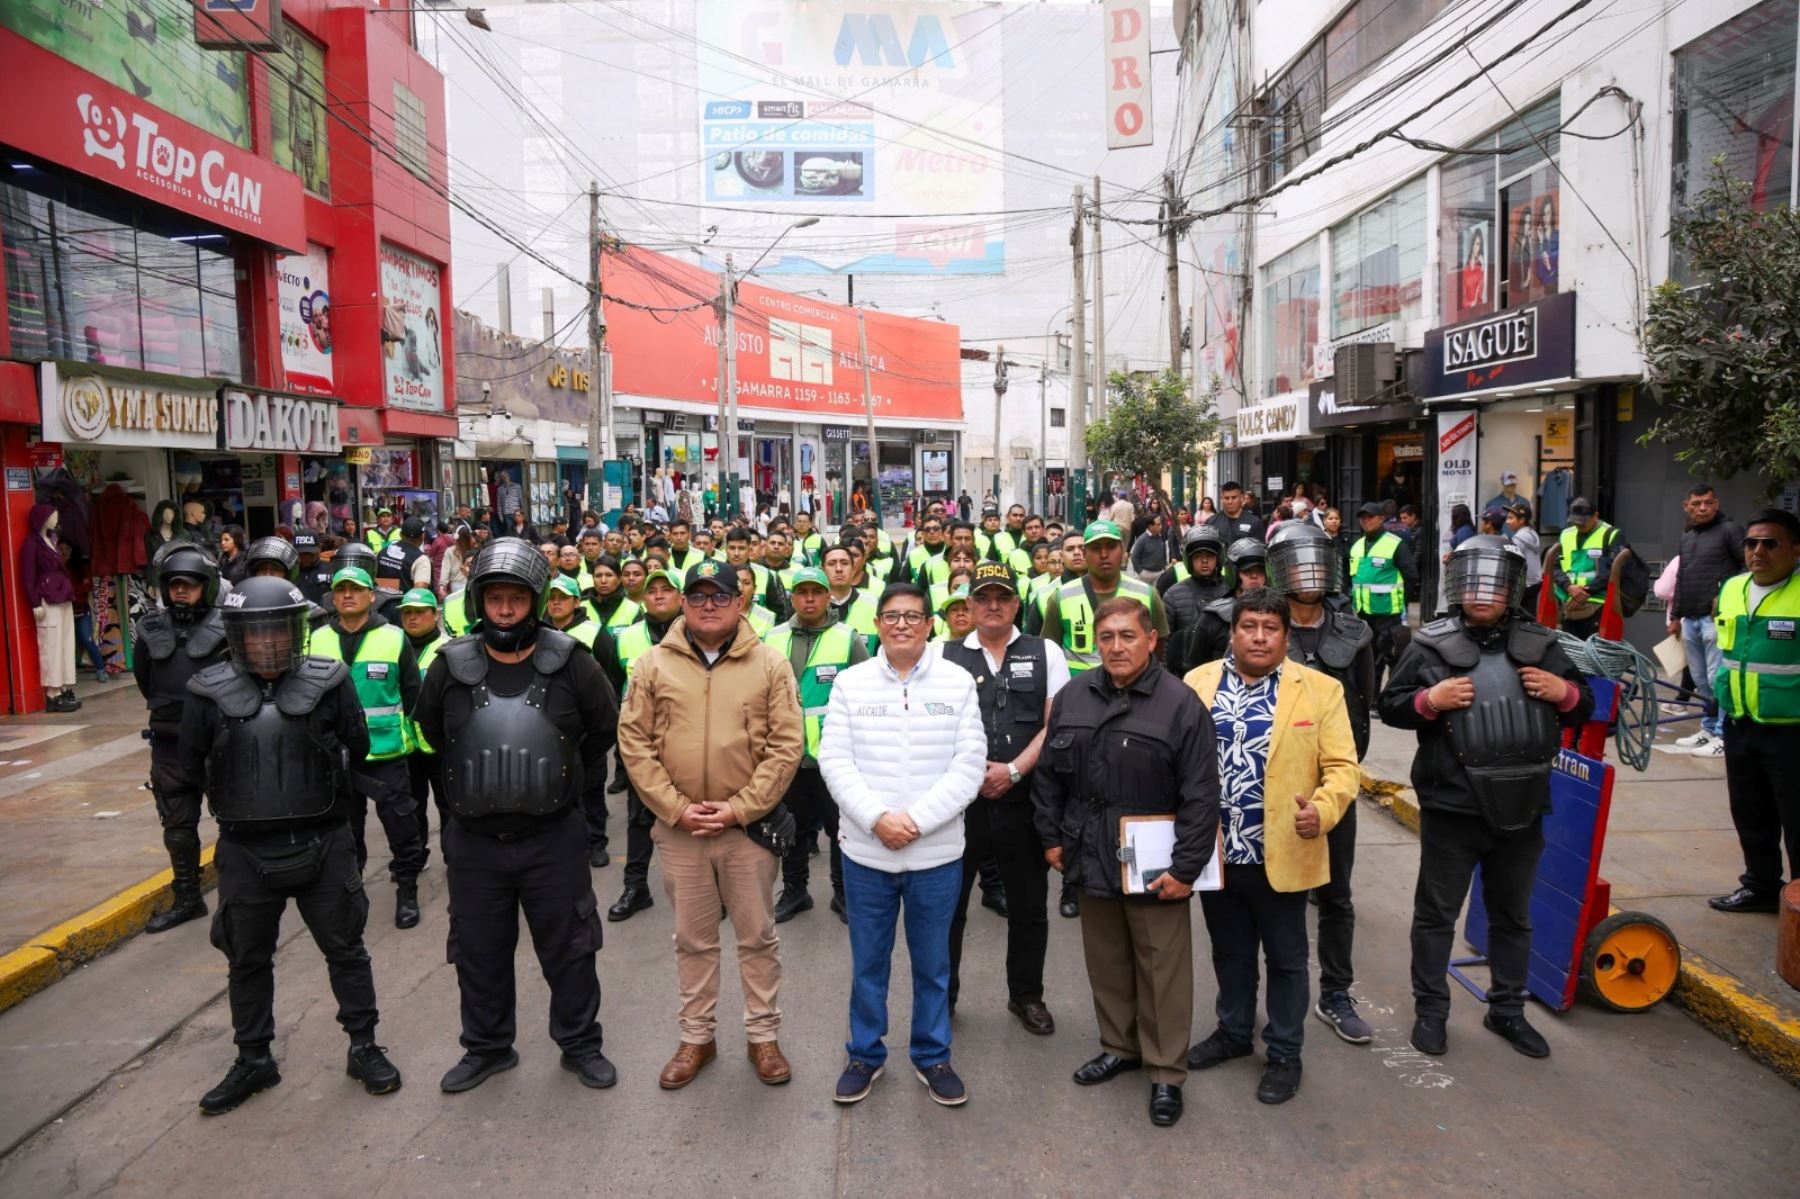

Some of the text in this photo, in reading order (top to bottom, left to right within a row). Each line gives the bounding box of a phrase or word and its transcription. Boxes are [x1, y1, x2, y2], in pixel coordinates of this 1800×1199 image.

[771, 76, 787, 87] EL
[793, 76, 829, 87] MALL
[710, 126, 869, 143] Patio de comidas
[896, 148, 993, 175] Metro
[136, 169, 262, 225] ACCESORIOS PARA MASCOTAS
[759, 295, 840, 322] CENTRO COMERCIAL
[704, 325, 886, 373] AUUSTO ALLCA
[794, 387, 817, 403] 1159
[828, 391, 850, 406] 1163
[861, 394, 882, 407] 167
[109, 387, 218, 434] YMA SUMAC
[228, 391, 343, 452] DAKOTA
[1238, 404, 1297, 437] DULCE CANDY
[1441, 469, 1472, 477] MONEY
[1443, 459, 1471, 470] OLD
[975, 565, 1011, 580] FISCA
[856, 704, 889, 717] ALCALDE
